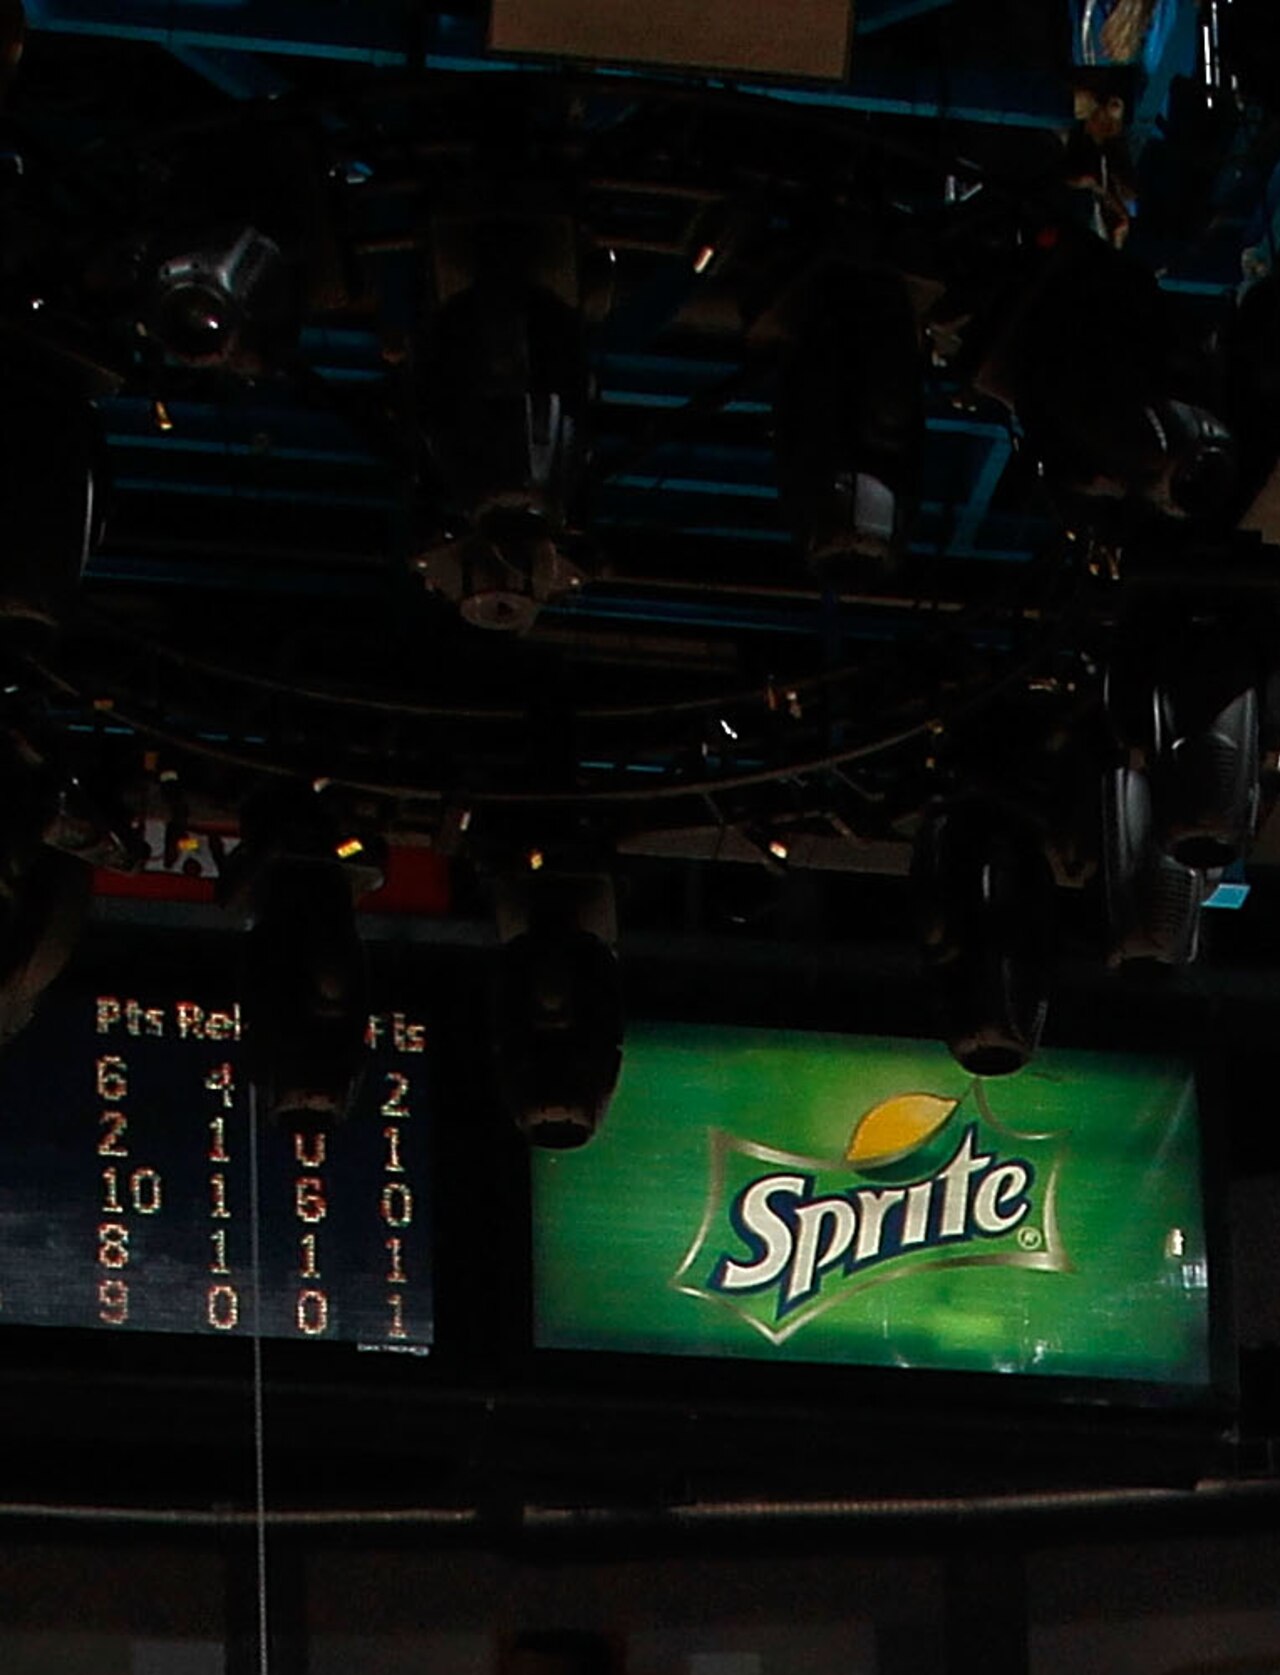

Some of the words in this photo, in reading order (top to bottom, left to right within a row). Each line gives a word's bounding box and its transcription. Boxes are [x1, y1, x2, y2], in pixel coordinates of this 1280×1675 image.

[97, 996, 163, 1037] Pts
[97, 1056, 127, 1100] 6
[381, 1072, 410, 1117] 2
[98, 1111, 128, 1157] 2
[209, 1117, 231, 1162] 1
[384, 1127, 405, 1171] 1
[101, 1166, 161, 1214] 10
[210, 1173, 231, 1218] 1
[381, 1183, 413, 1228] 0
[712, 1121, 1030, 1316] Sprite
[99, 1223, 129, 1268] 8
[209, 1229, 231, 1274] 1
[300, 1234, 320, 1279] 1
[386, 1239, 406, 1283] 1
[208, 1285, 238, 1330] 0
[298, 1289, 328, 1335] 0
[388, 1293, 408, 1338] 1
